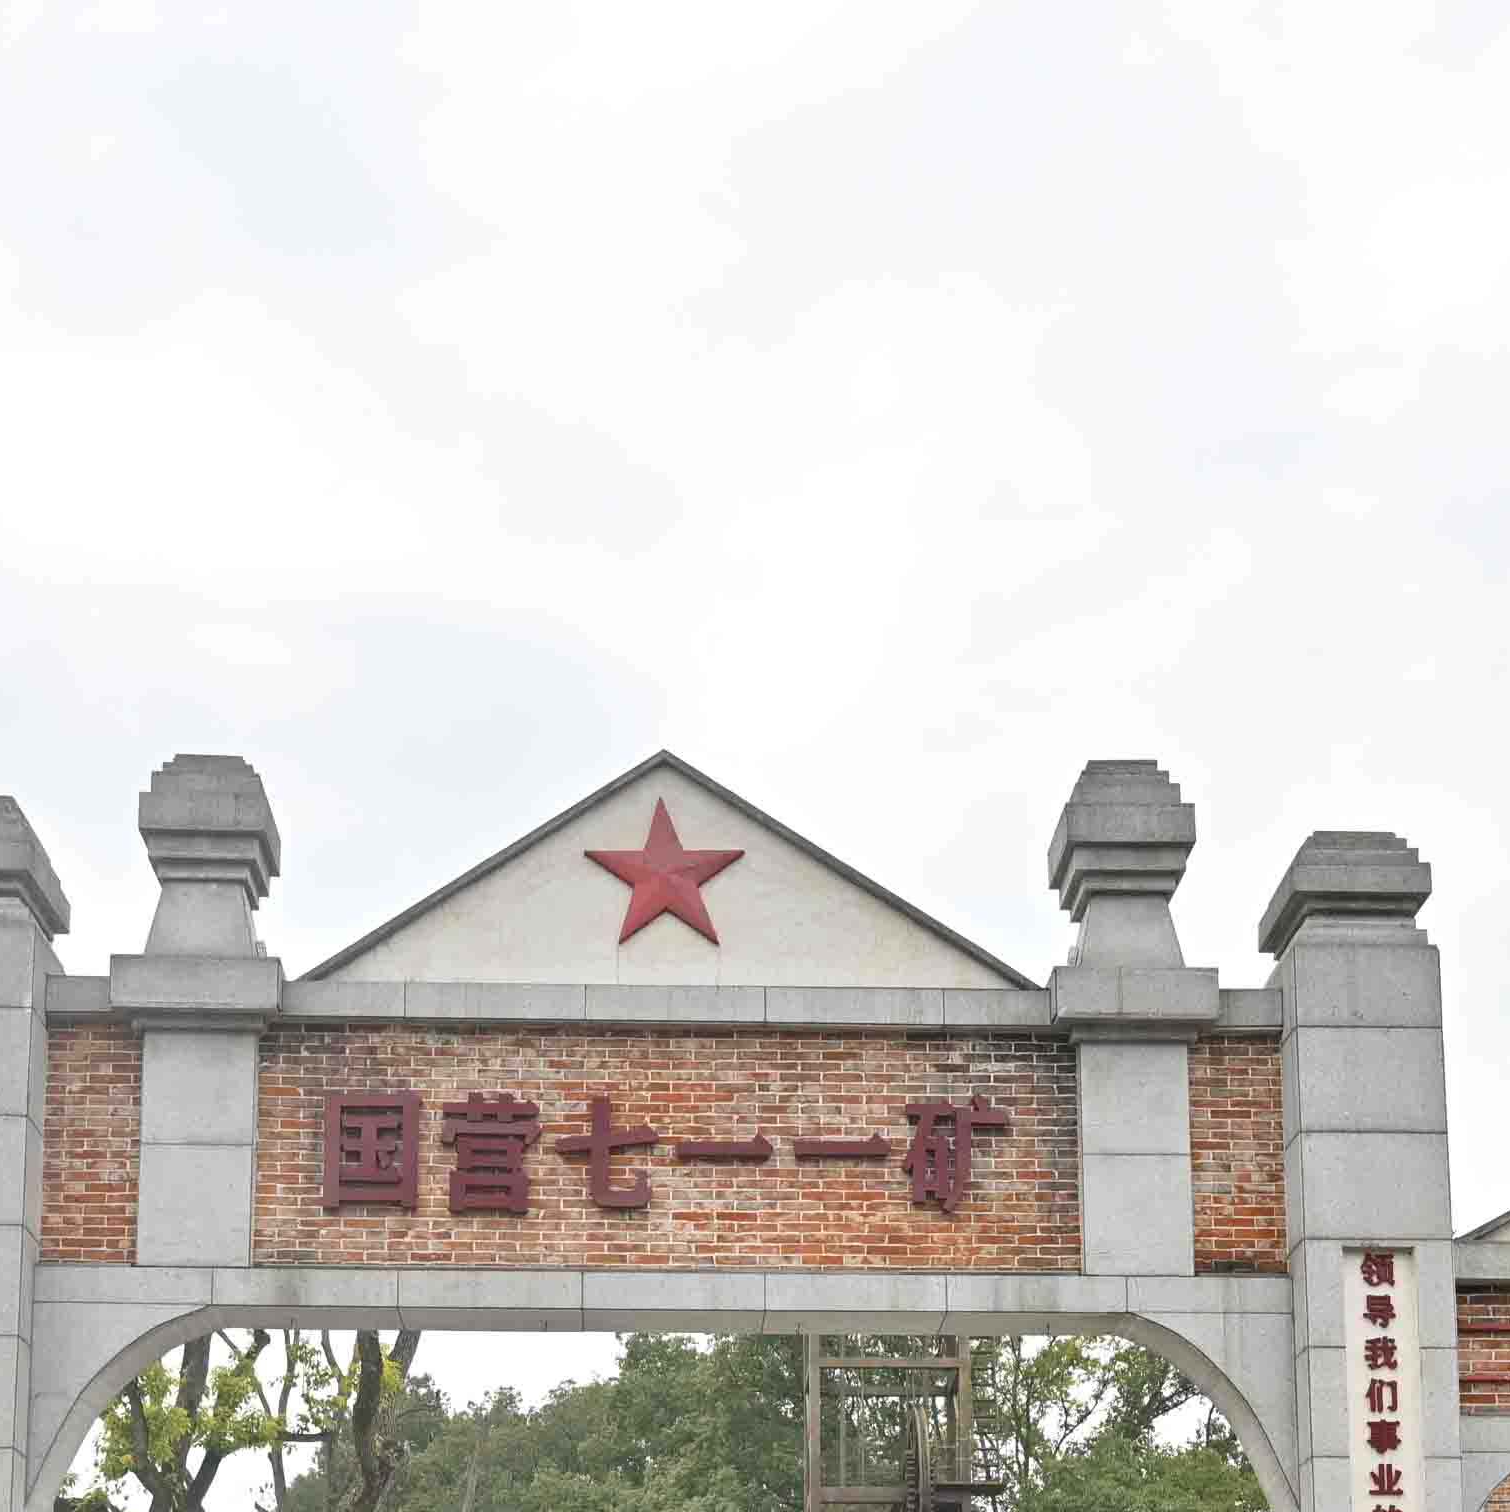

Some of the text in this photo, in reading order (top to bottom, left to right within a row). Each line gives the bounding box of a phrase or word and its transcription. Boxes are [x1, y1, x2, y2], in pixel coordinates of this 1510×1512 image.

[322, 1092, 1012, 1214] 国营七一一矿
